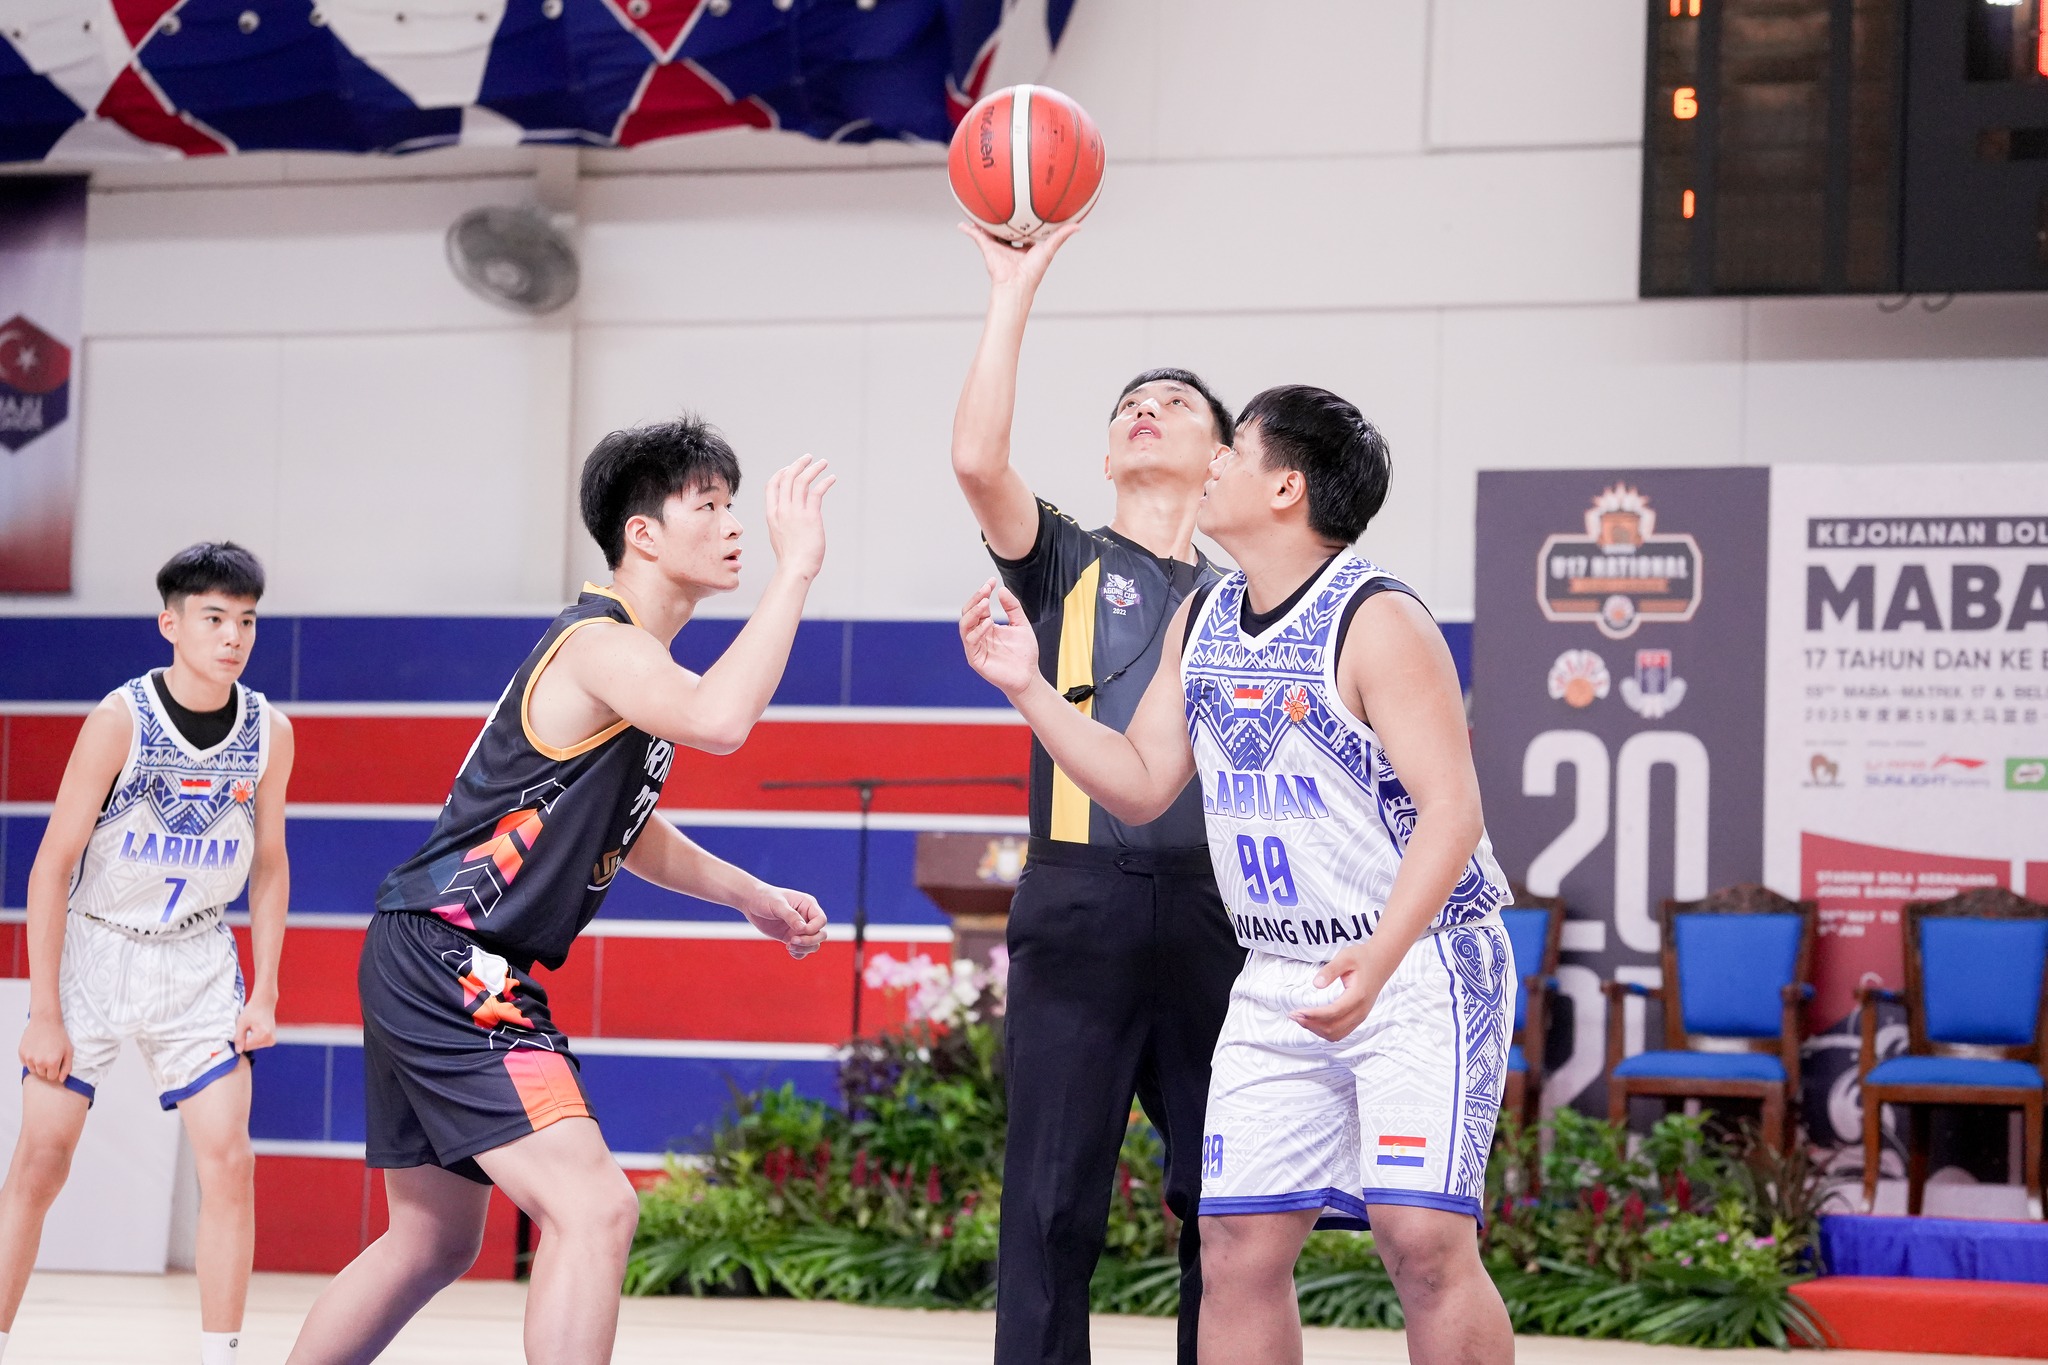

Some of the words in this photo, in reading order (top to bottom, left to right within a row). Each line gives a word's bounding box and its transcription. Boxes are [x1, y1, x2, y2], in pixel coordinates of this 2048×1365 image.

[1673, 87, 1698, 119] 6
[980, 105, 995, 169] molten
[1815, 521, 1986, 546] KEJOHANAN
[1806, 563, 2048, 632] MABA
[1804, 649, 1828, 671] 17
[1836, 648, 1925, 671] TAHUN
[1934, 648, 1991, 671] DAN
[2000, 648, 2033, 671] KE
[1200, 769, 1330, 822] LABUAN
[119, 830, 240, 870] LABUAN
[1522, 729, 1710, 953] 20
[1236, 833, 1299, 907] 99
[160, 877, 187, 923] 7
[1301, 909, 1380, 946] MAJU
